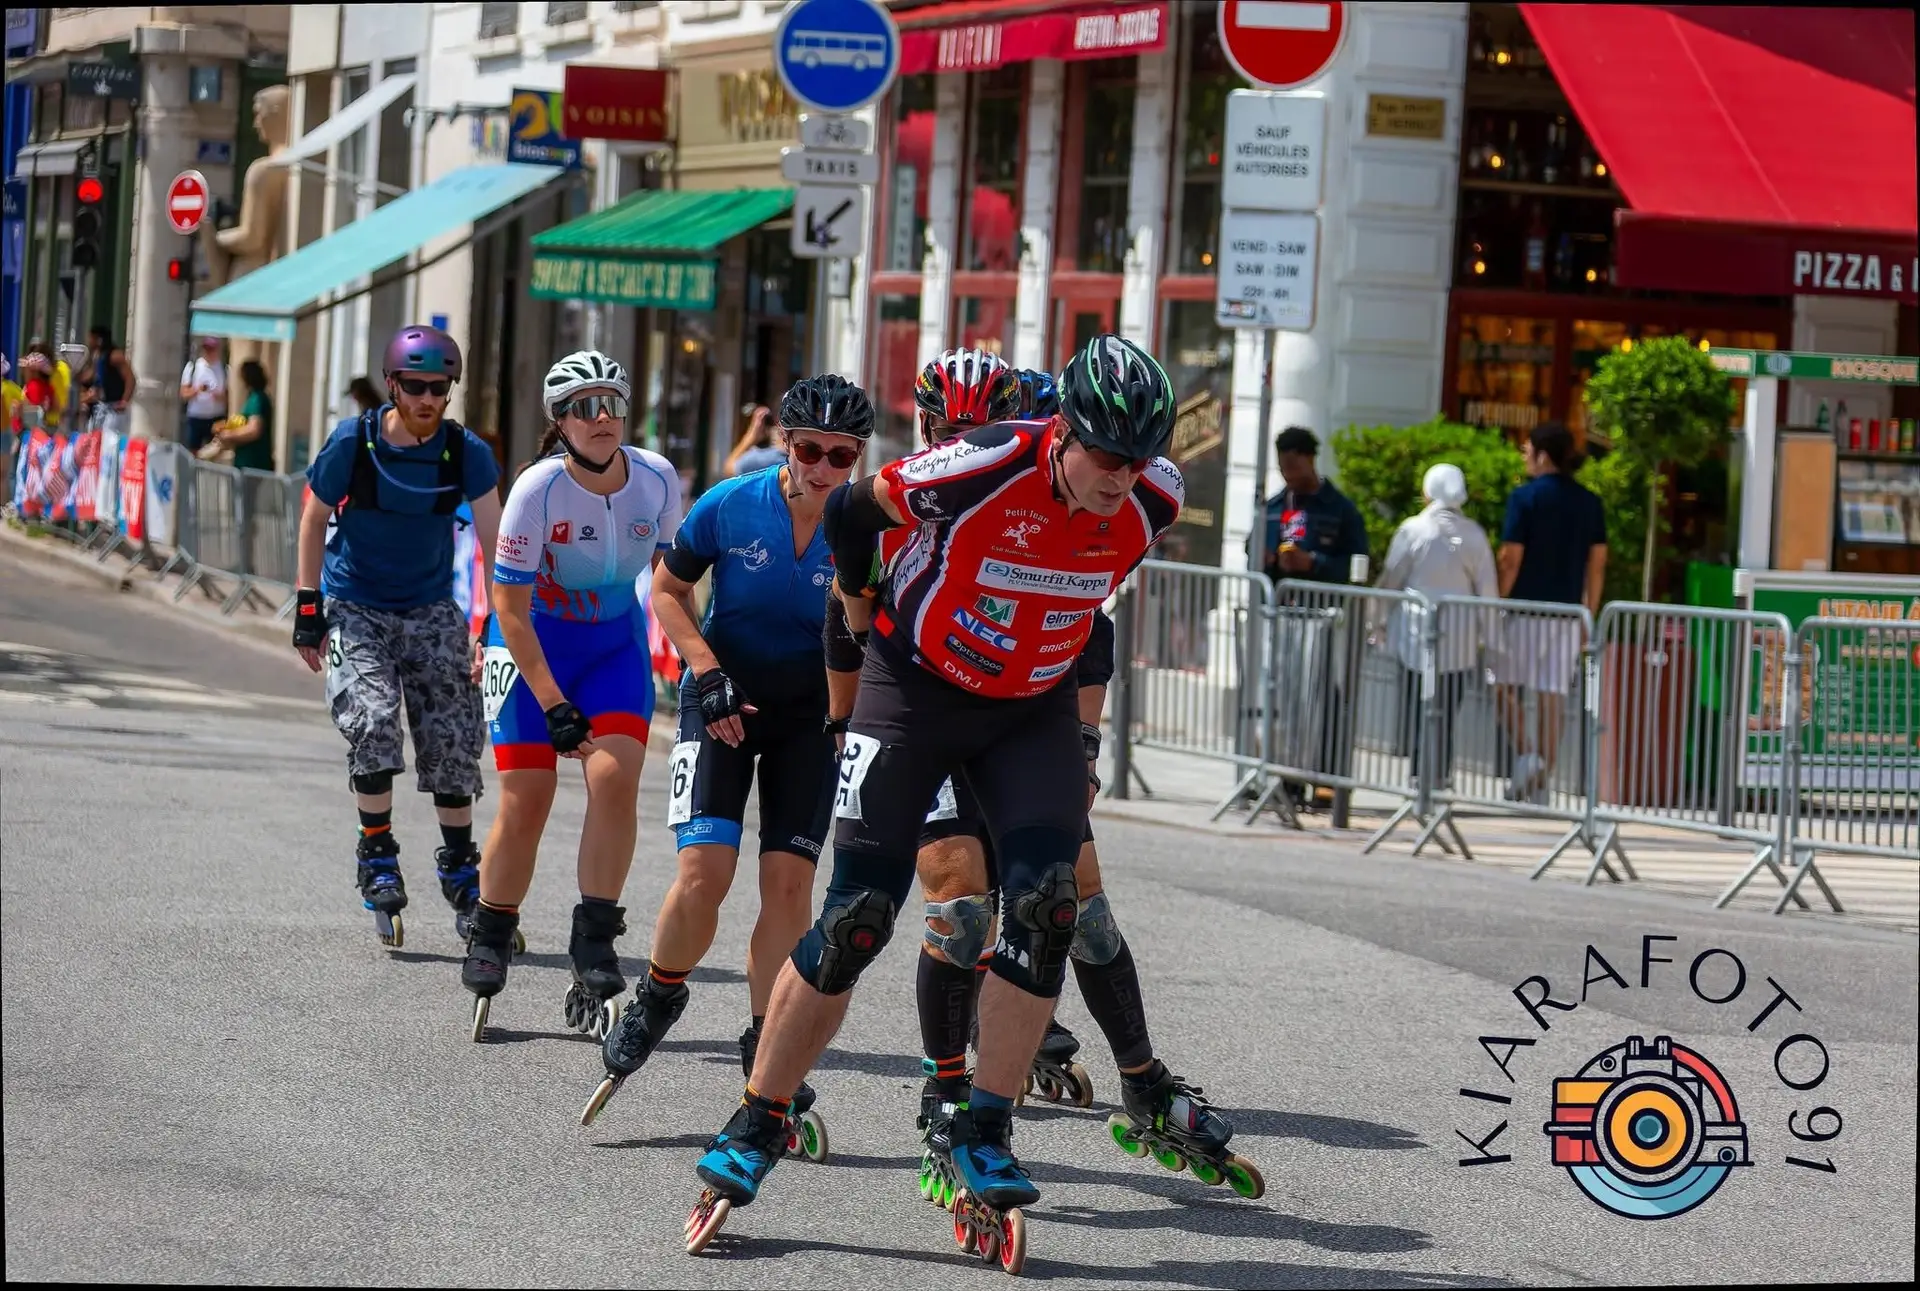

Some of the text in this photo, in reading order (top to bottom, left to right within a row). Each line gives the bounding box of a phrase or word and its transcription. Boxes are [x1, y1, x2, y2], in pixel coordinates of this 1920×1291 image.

[568, 104, 665, 128] VOISIN
[1256, 125, 1291, 140] SAUF
[804, 157, 858, 178] TAXIS
[1794, 250, 1882, 291] PIZZA
[1890, 264, 1904, 292] &
[1005, 508, 1050, 525] Petit Jean
[1010, 567, 1066, 585] Smurfit
[1066, 575, 1108, 592] Kappa
[952, 606, 1019, 652] NEC
[953, 638, 1003, 671] Optic 2000
[1038, 639, 1071, 653] BRICO
[484, 659, 516, 697] 260
[944, 660, 982, 689] DMJ
[671, 757, 689, 799] 6
[836, 742, 862, 807] 375
